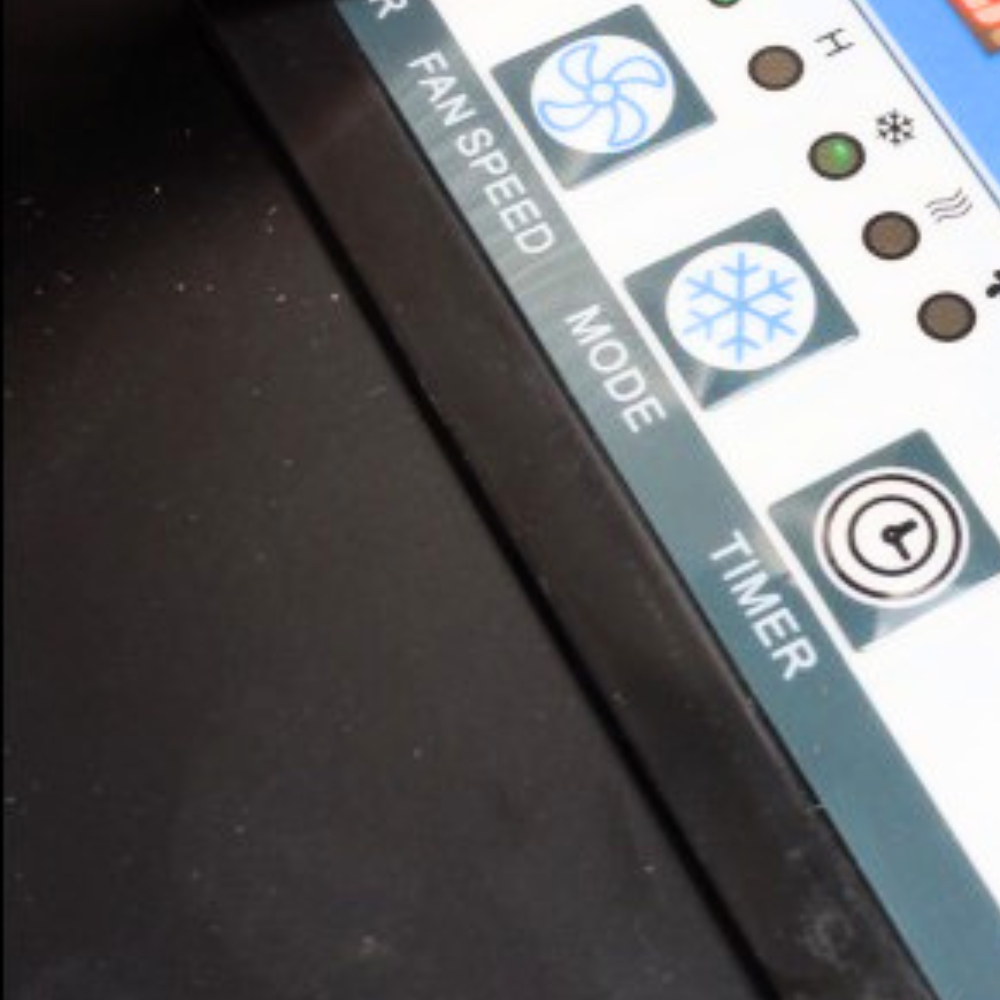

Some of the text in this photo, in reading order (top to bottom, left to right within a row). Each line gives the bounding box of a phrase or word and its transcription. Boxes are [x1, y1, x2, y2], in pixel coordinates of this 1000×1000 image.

[815, 27, 854, 57] H
[408, 50, 557, 258] FAN SPEED
[564, 303, 668, 434] MODE
[708, 529, 820, 683] TIMER
